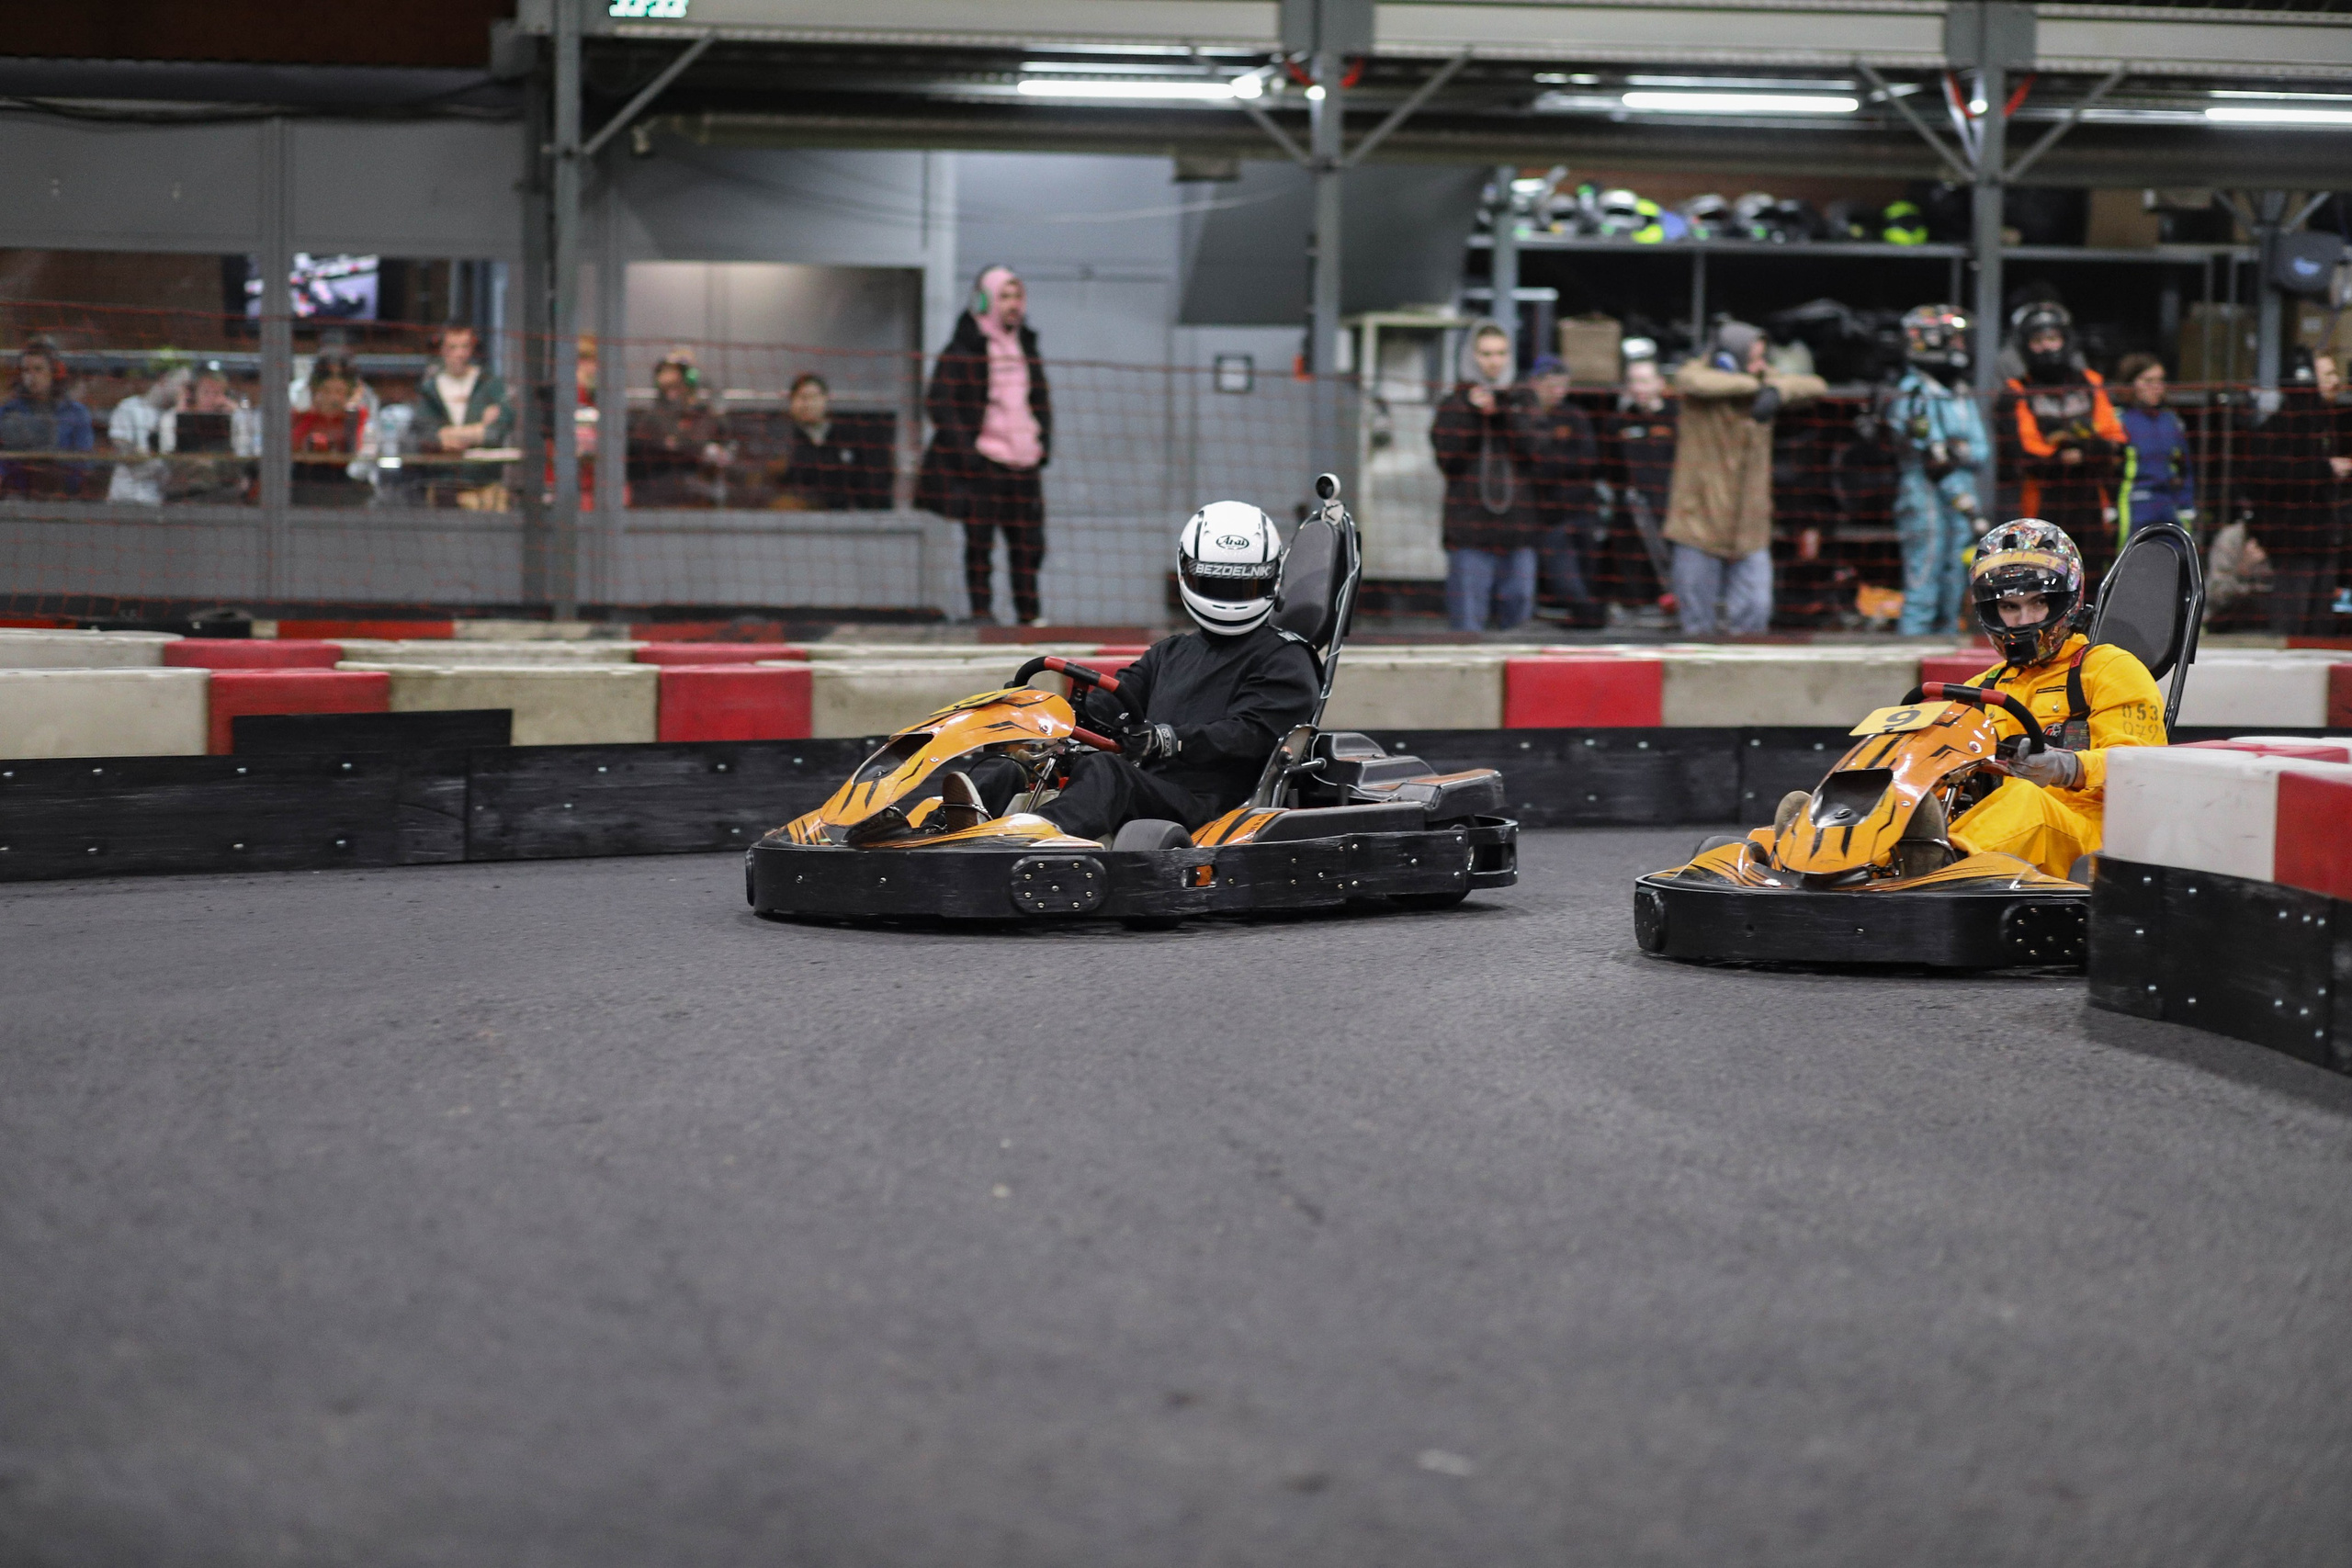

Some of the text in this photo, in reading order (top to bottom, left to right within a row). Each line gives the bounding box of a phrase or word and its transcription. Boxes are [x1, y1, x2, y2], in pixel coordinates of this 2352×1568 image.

[1220, 536, 1247, 547] Arai
[1195, 563, 1270, 576] BEZDELNIK
[1881, 709, 1922, 728] 9
